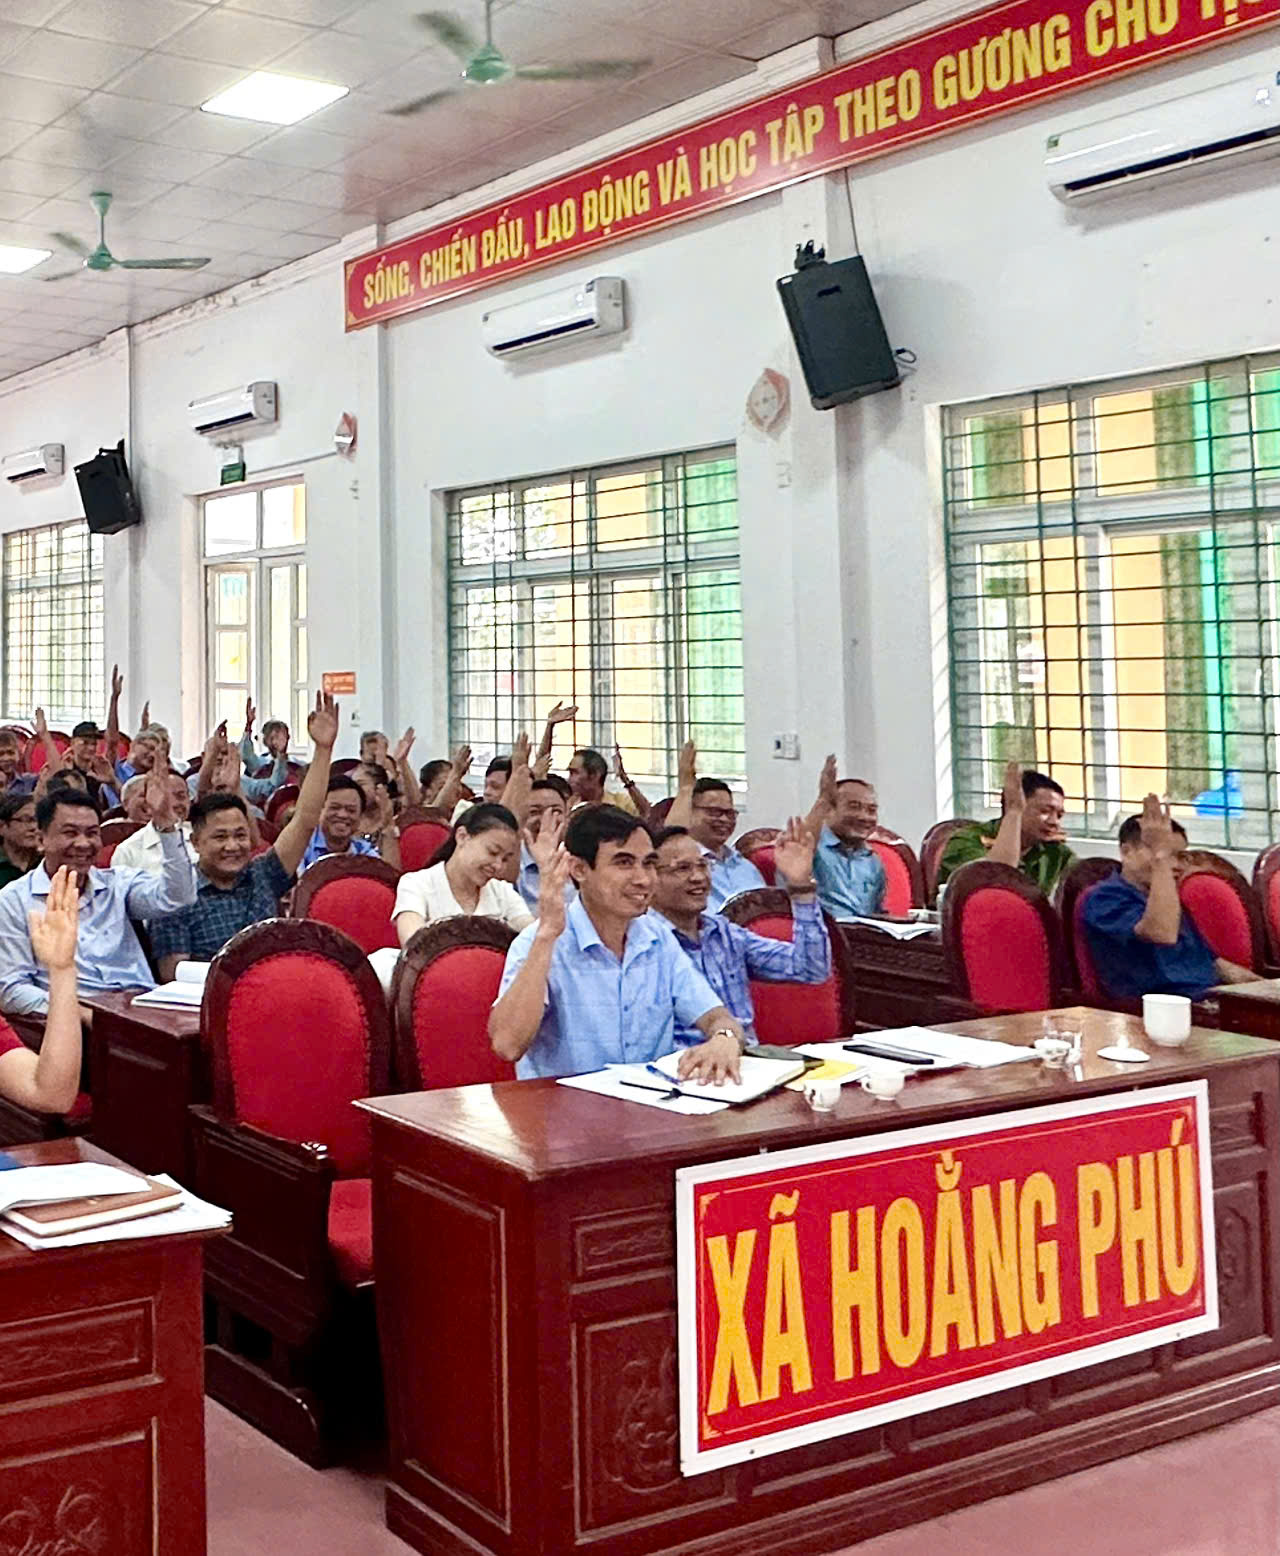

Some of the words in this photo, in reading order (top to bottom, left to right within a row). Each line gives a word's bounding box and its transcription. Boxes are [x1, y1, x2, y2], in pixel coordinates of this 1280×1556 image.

[363, 255, 415, 309] SỐNG,
[420, 227, 477, 289] CHIẾN
[481, 208, 529, 268] ĐẤU,
[535, 197, 577, 249] LAO
[582, 174, 651, 235] ĐỘNG
[656, 146, 693, 206] VÀ
[699, 130, 757, 193] HỌC
[765, 102, 824, 172] TẬP
[834, 69, 921, 143] THEO
[932, 13, 1072, 110] GƯƠNG
[706, 1189, 814, 1416] XÃ
[830, 1151, 1062, 1382] HOẰNG
[1075, 1118, 1200, 1317] PHÚ
